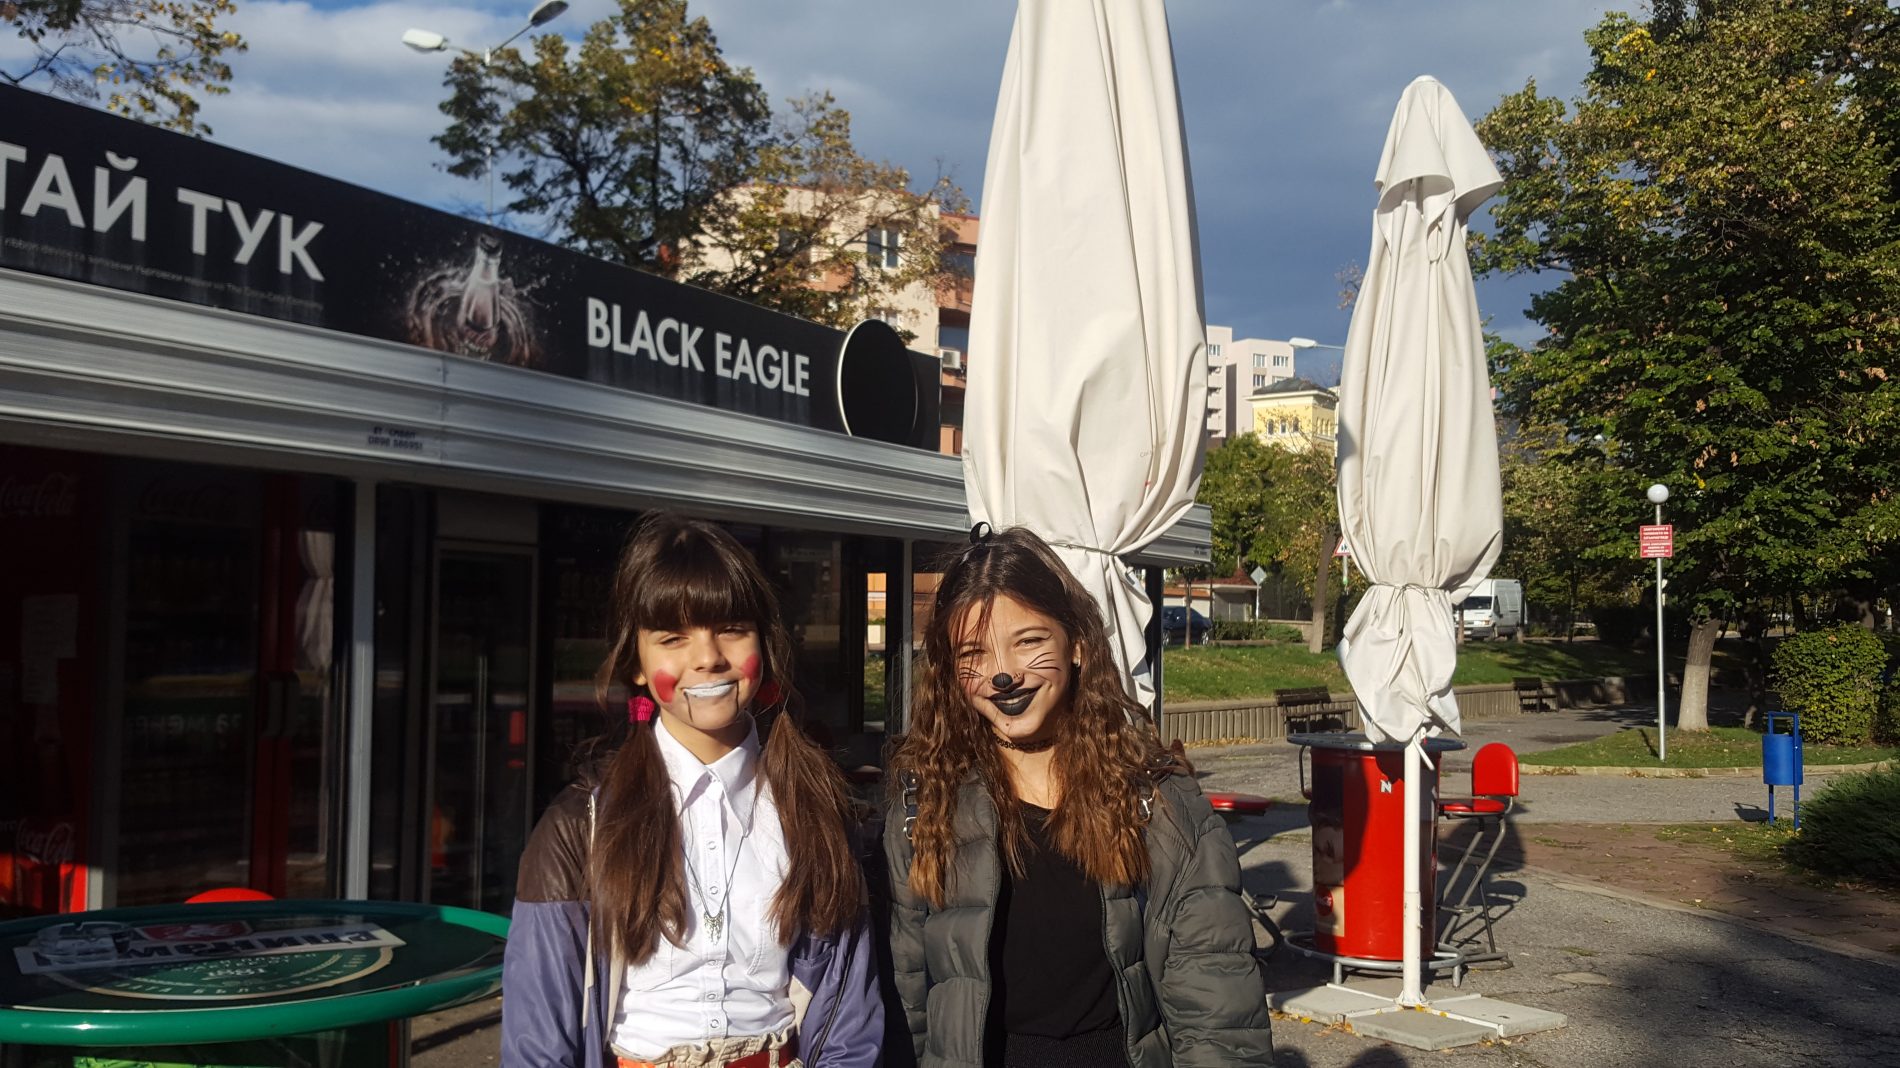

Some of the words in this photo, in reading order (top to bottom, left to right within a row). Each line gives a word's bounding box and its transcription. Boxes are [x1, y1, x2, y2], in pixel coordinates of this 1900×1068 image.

[177, 187, 325, 282] ТУК
[588, 297, 705, 372] BLACK
[715, 332, 811, 397] EAGLE
[33, 930, 380, 967] меница
